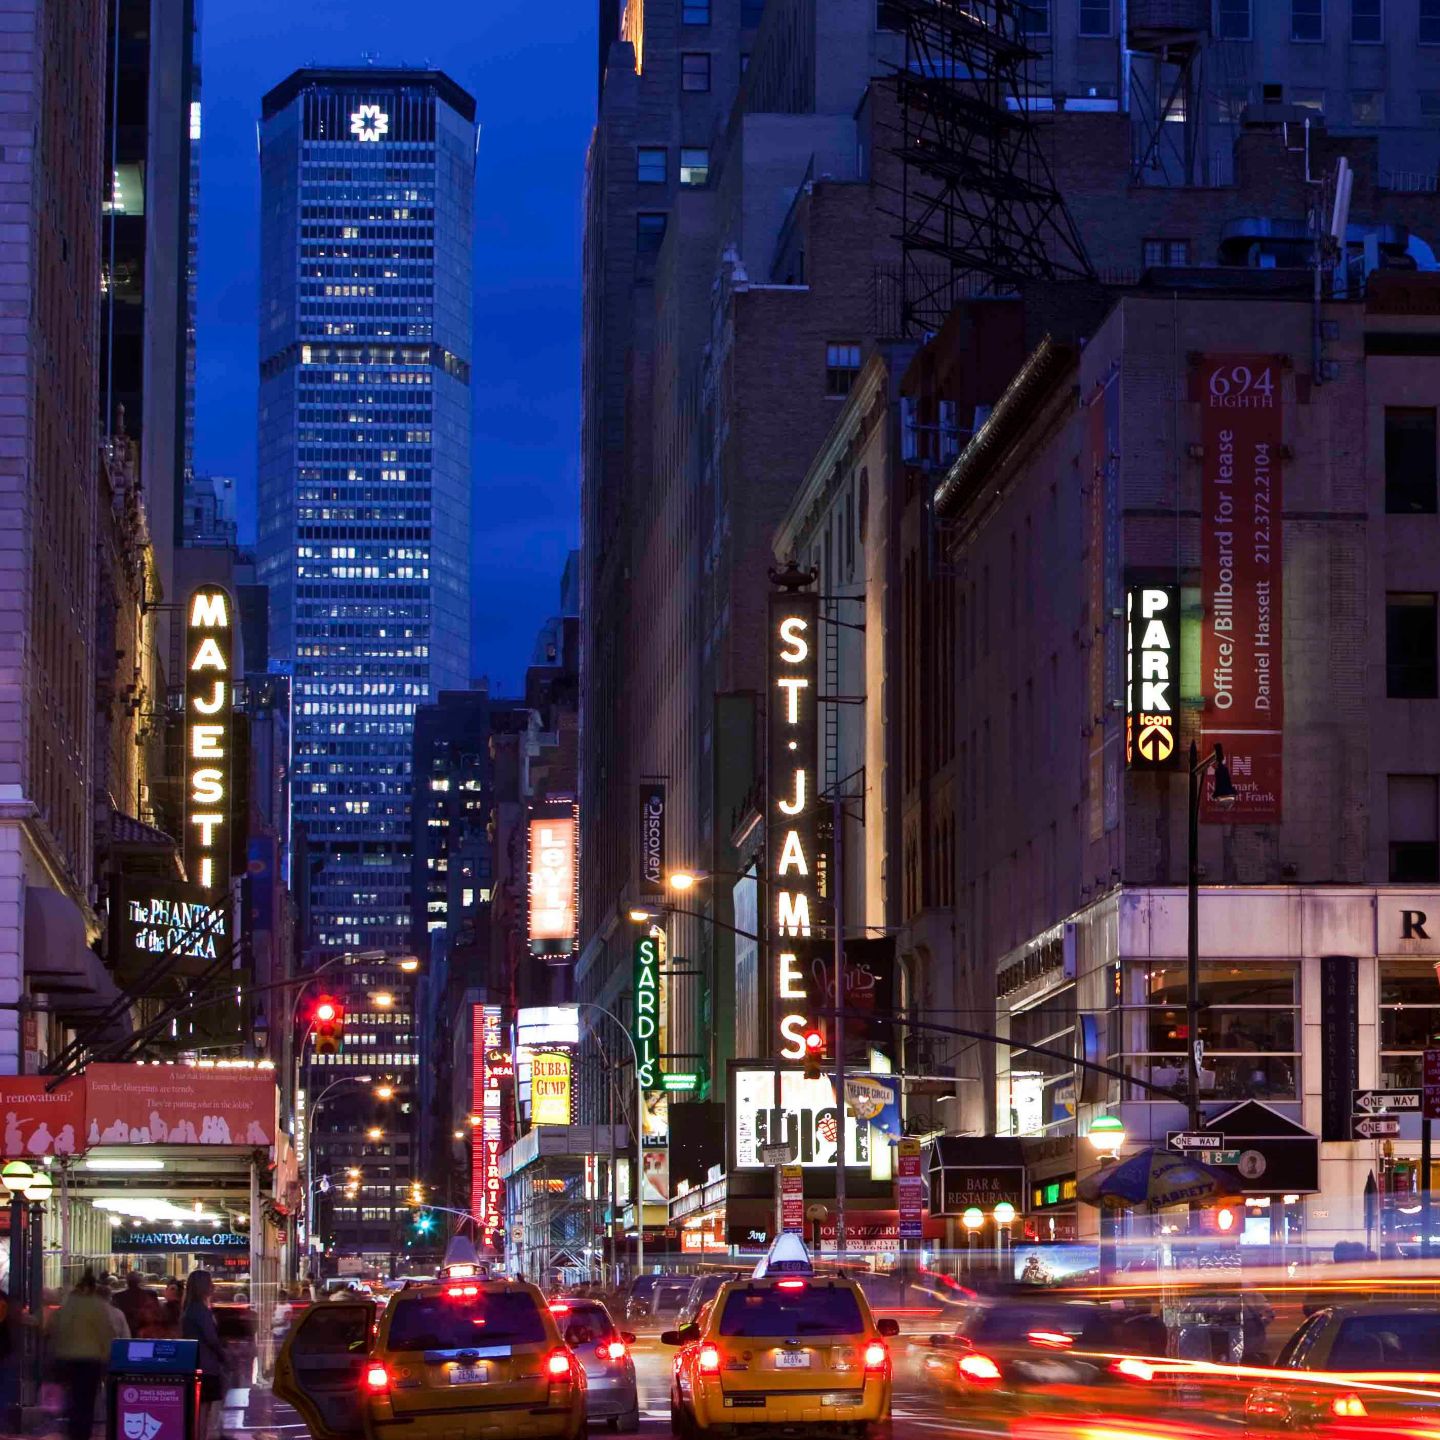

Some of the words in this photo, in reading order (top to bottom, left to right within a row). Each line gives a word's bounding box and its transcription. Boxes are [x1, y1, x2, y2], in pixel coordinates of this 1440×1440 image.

[1209, 366, 1275, 397] 694
[1210, 395, 1273, 408] EIGHTH
[1214, 429, 1233, 485] lease
[1214, 490, 1233, 525] for
[1254, 443, 1270, 564] 212.372.2104
[1214, 531, 1236, 710] Office/Billboard
[1255, 580, 1270, 647] Hassett
[1141, 589, 1171, 711] PARK
[1254, 652, 1270, 710] Daniel
[1139, 713, 1172, 726] icon
[191, 594, 228, 888] MAJESTI
[1207, 780, 1259, 791] Nmark
[1245, 792, 1276, 802] Frank
[646, 803, 663, 884] Discovery
[128, 900, 149, 923] The
[778, 769, 811, 1060] JAMES
[135, 928, 149, 949] of
[149, 930, 165, 953] the
[533, 1059, 569, 1076] BUBBA
[536, 1079, 566, 1096] GUMP
[1363, 1097, 1384, 1107] ONE
[1393, 1096, 1415, 1106] WAY
[1361, 1123, 1382, 1133] ONE
[1175, 1137, 1193, 1146] ONE
[1199, 1136, 1218, 1146] WAY
[1214, 1152, 1223, 1164] 8
[967, 1178, 989, 1191] BAR
[991, 1178, 1000, 1190] &
[1152, 1183, 1215, 1207] SABRETT
[948, 1191, 1020, 1205] RESTAURANT
[129, 1233, 190, 1245] PHANTOM
[191, 1235, 200, 1245] of
[200, 1235, 212, 1245] the
